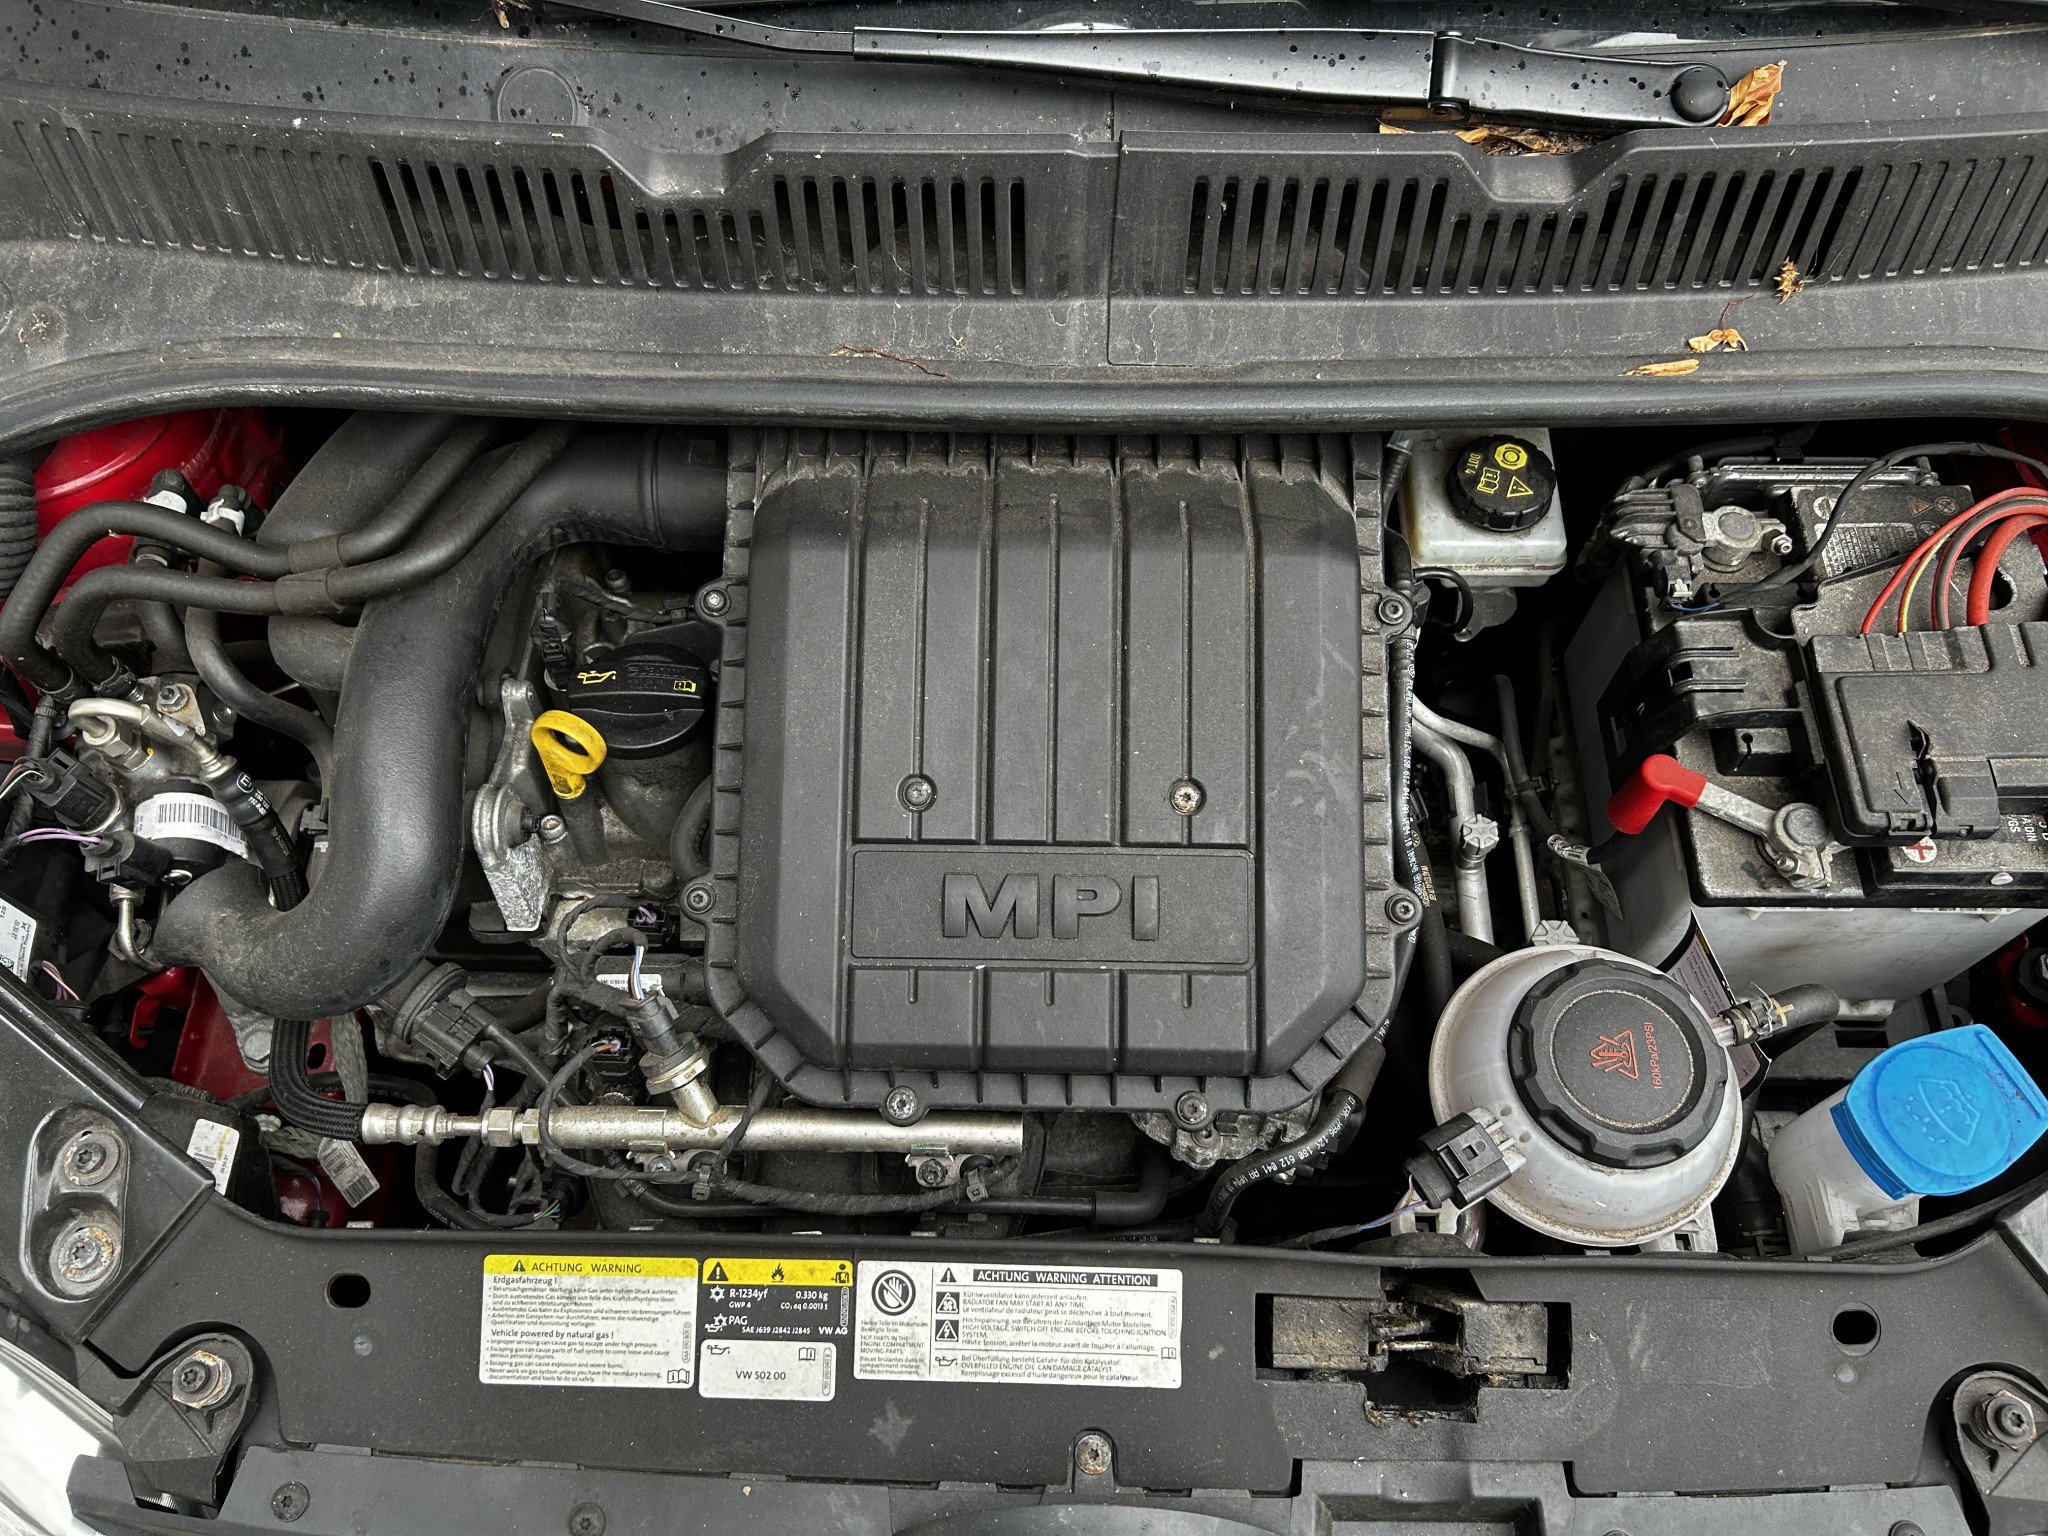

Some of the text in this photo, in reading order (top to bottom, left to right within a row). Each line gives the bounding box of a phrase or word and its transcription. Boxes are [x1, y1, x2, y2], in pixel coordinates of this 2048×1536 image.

[2025, 827, 2037, 841] DIN
[942, 872, 1160, 941] MPI
[1644, 1022, 1662, 1090] 160kPa/23PSI
[1279, 1155, 1295, 1167] 612
[532, 1263, 641, 1273] ACHTUNG WARNING
[494, 1276, 552, 1285] Erdgasfahrzeug
[978, 1271, 1150, 1285] ACHTUNG WARNING ATTENTION
[730, 1289, 768, 1300] R-1234yf
[796, 1291, 828, 1301] 0.330 kg
[729, 1316, 747, 1325] PAG
[521, 1330, 553, 1338] powered
[556, 1330, 565, 1339] by
[819, 1327, 848, 1335] VW AG
[736, 1371, 786, 1380] VW 502 00
